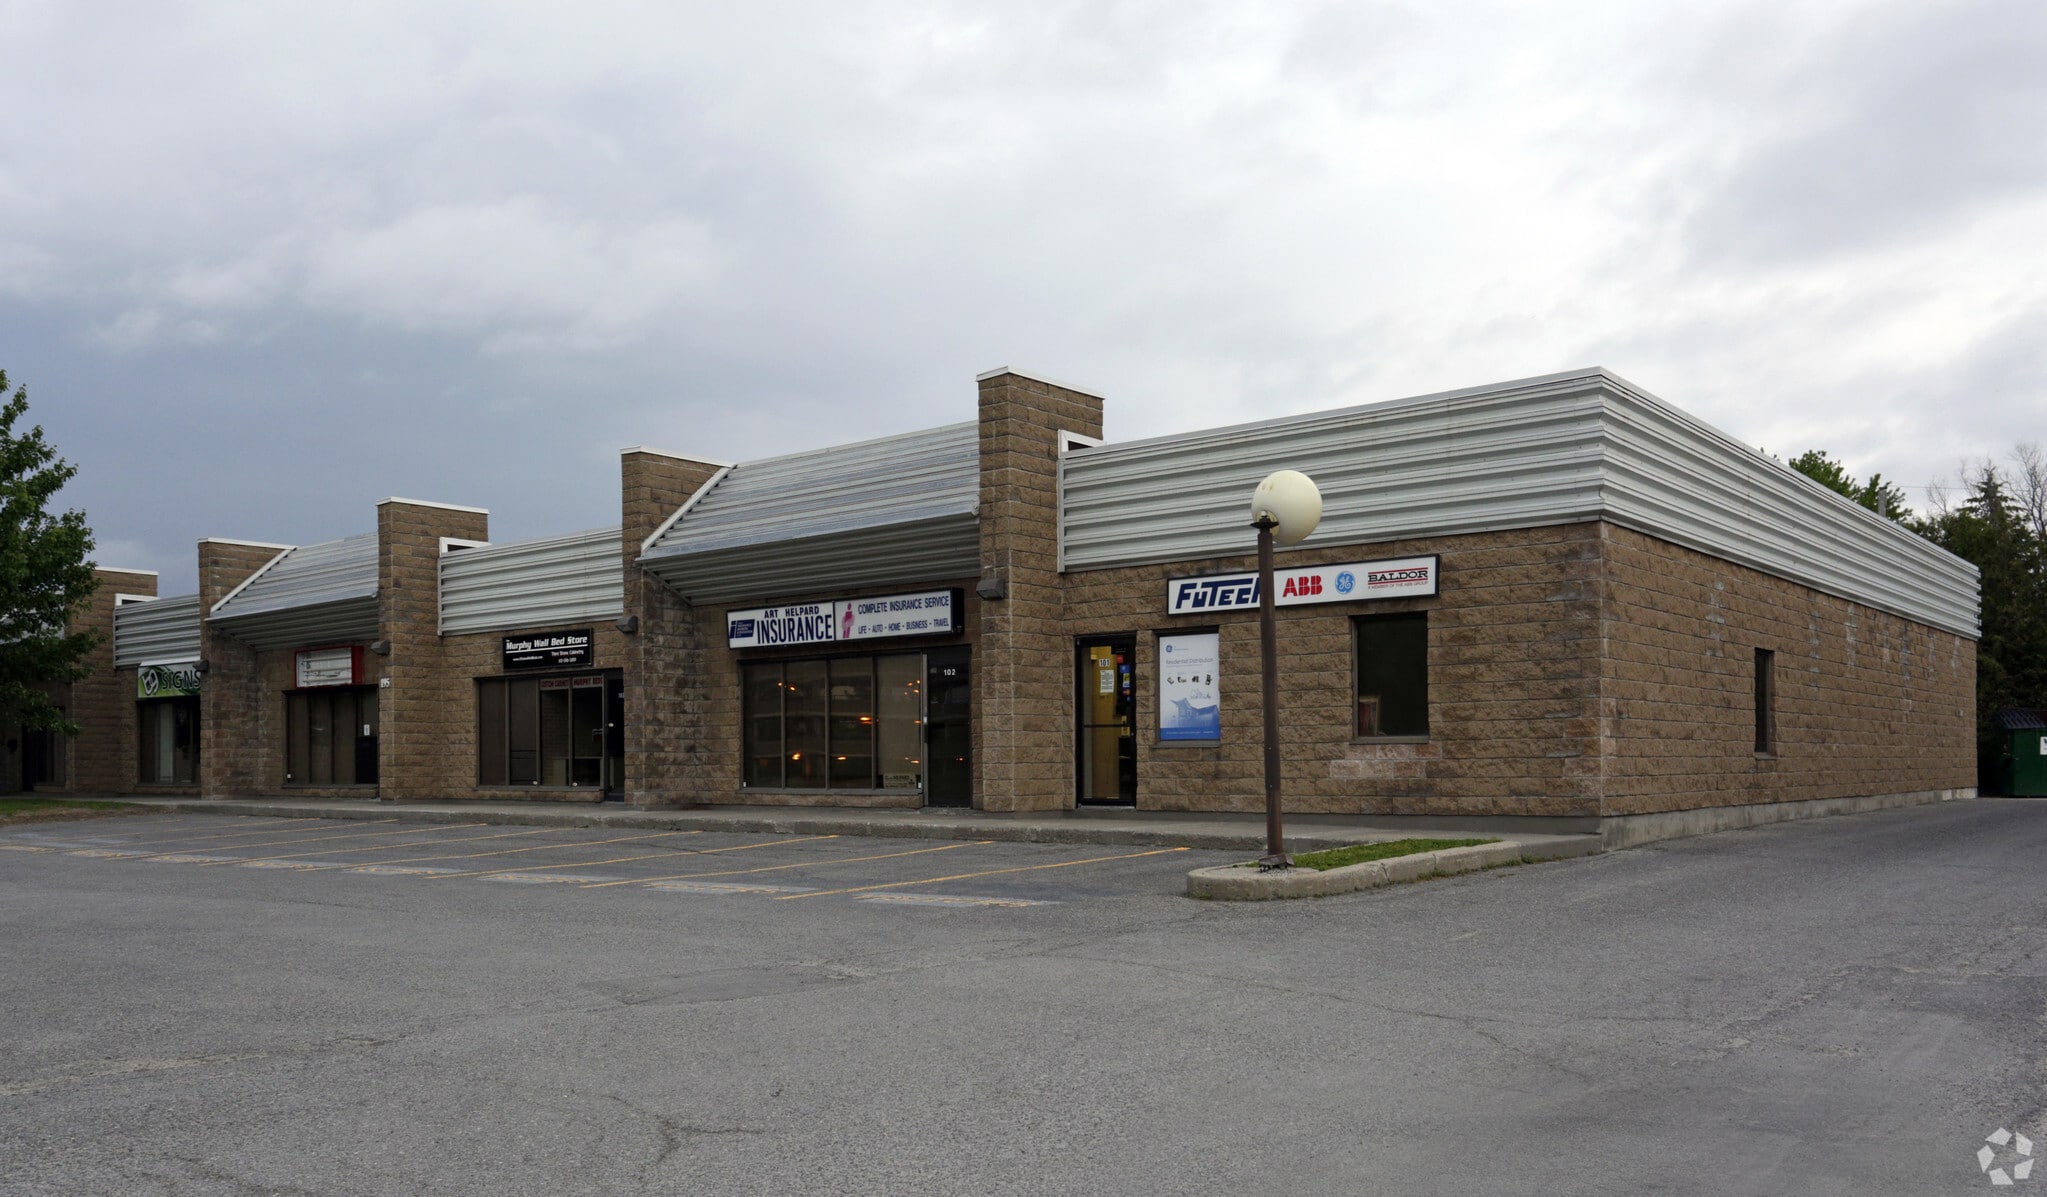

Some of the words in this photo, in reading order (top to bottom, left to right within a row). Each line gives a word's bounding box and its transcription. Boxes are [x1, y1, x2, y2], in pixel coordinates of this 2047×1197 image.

[1368, 570, 1428, 583] BALDOR
[1282, 575, 1323, 597] ABB
[764, 609, 779, 619] ART
[785, 605, 820, 617] HELPARD
[858, 601, 888, 615] COMPLETE
[890, 598, 922, 612] INSURANCE
[925, 595, 949, 608] SERVICE
[757, 614, 833, 645] INSURANCE
[858, 625, 867, 634] LIFE
[872, 622, 884, 632] AUTO
[888, 622, 902, 631] HOME
[906, 620, 928, 630] BUSINESS
[934, 617, 949, 627] TRAVEL
[506, 641, 532, 651] Murphy
[534, 638, 549, 648] Wall
[551, 637, 565, 647] Bed
[567, 635, 588, 645] Store
[1100, 659, 1110, 667] 101
[162, 670, 200, 690] SIGNS
[944, 668, 956, 676] 102
